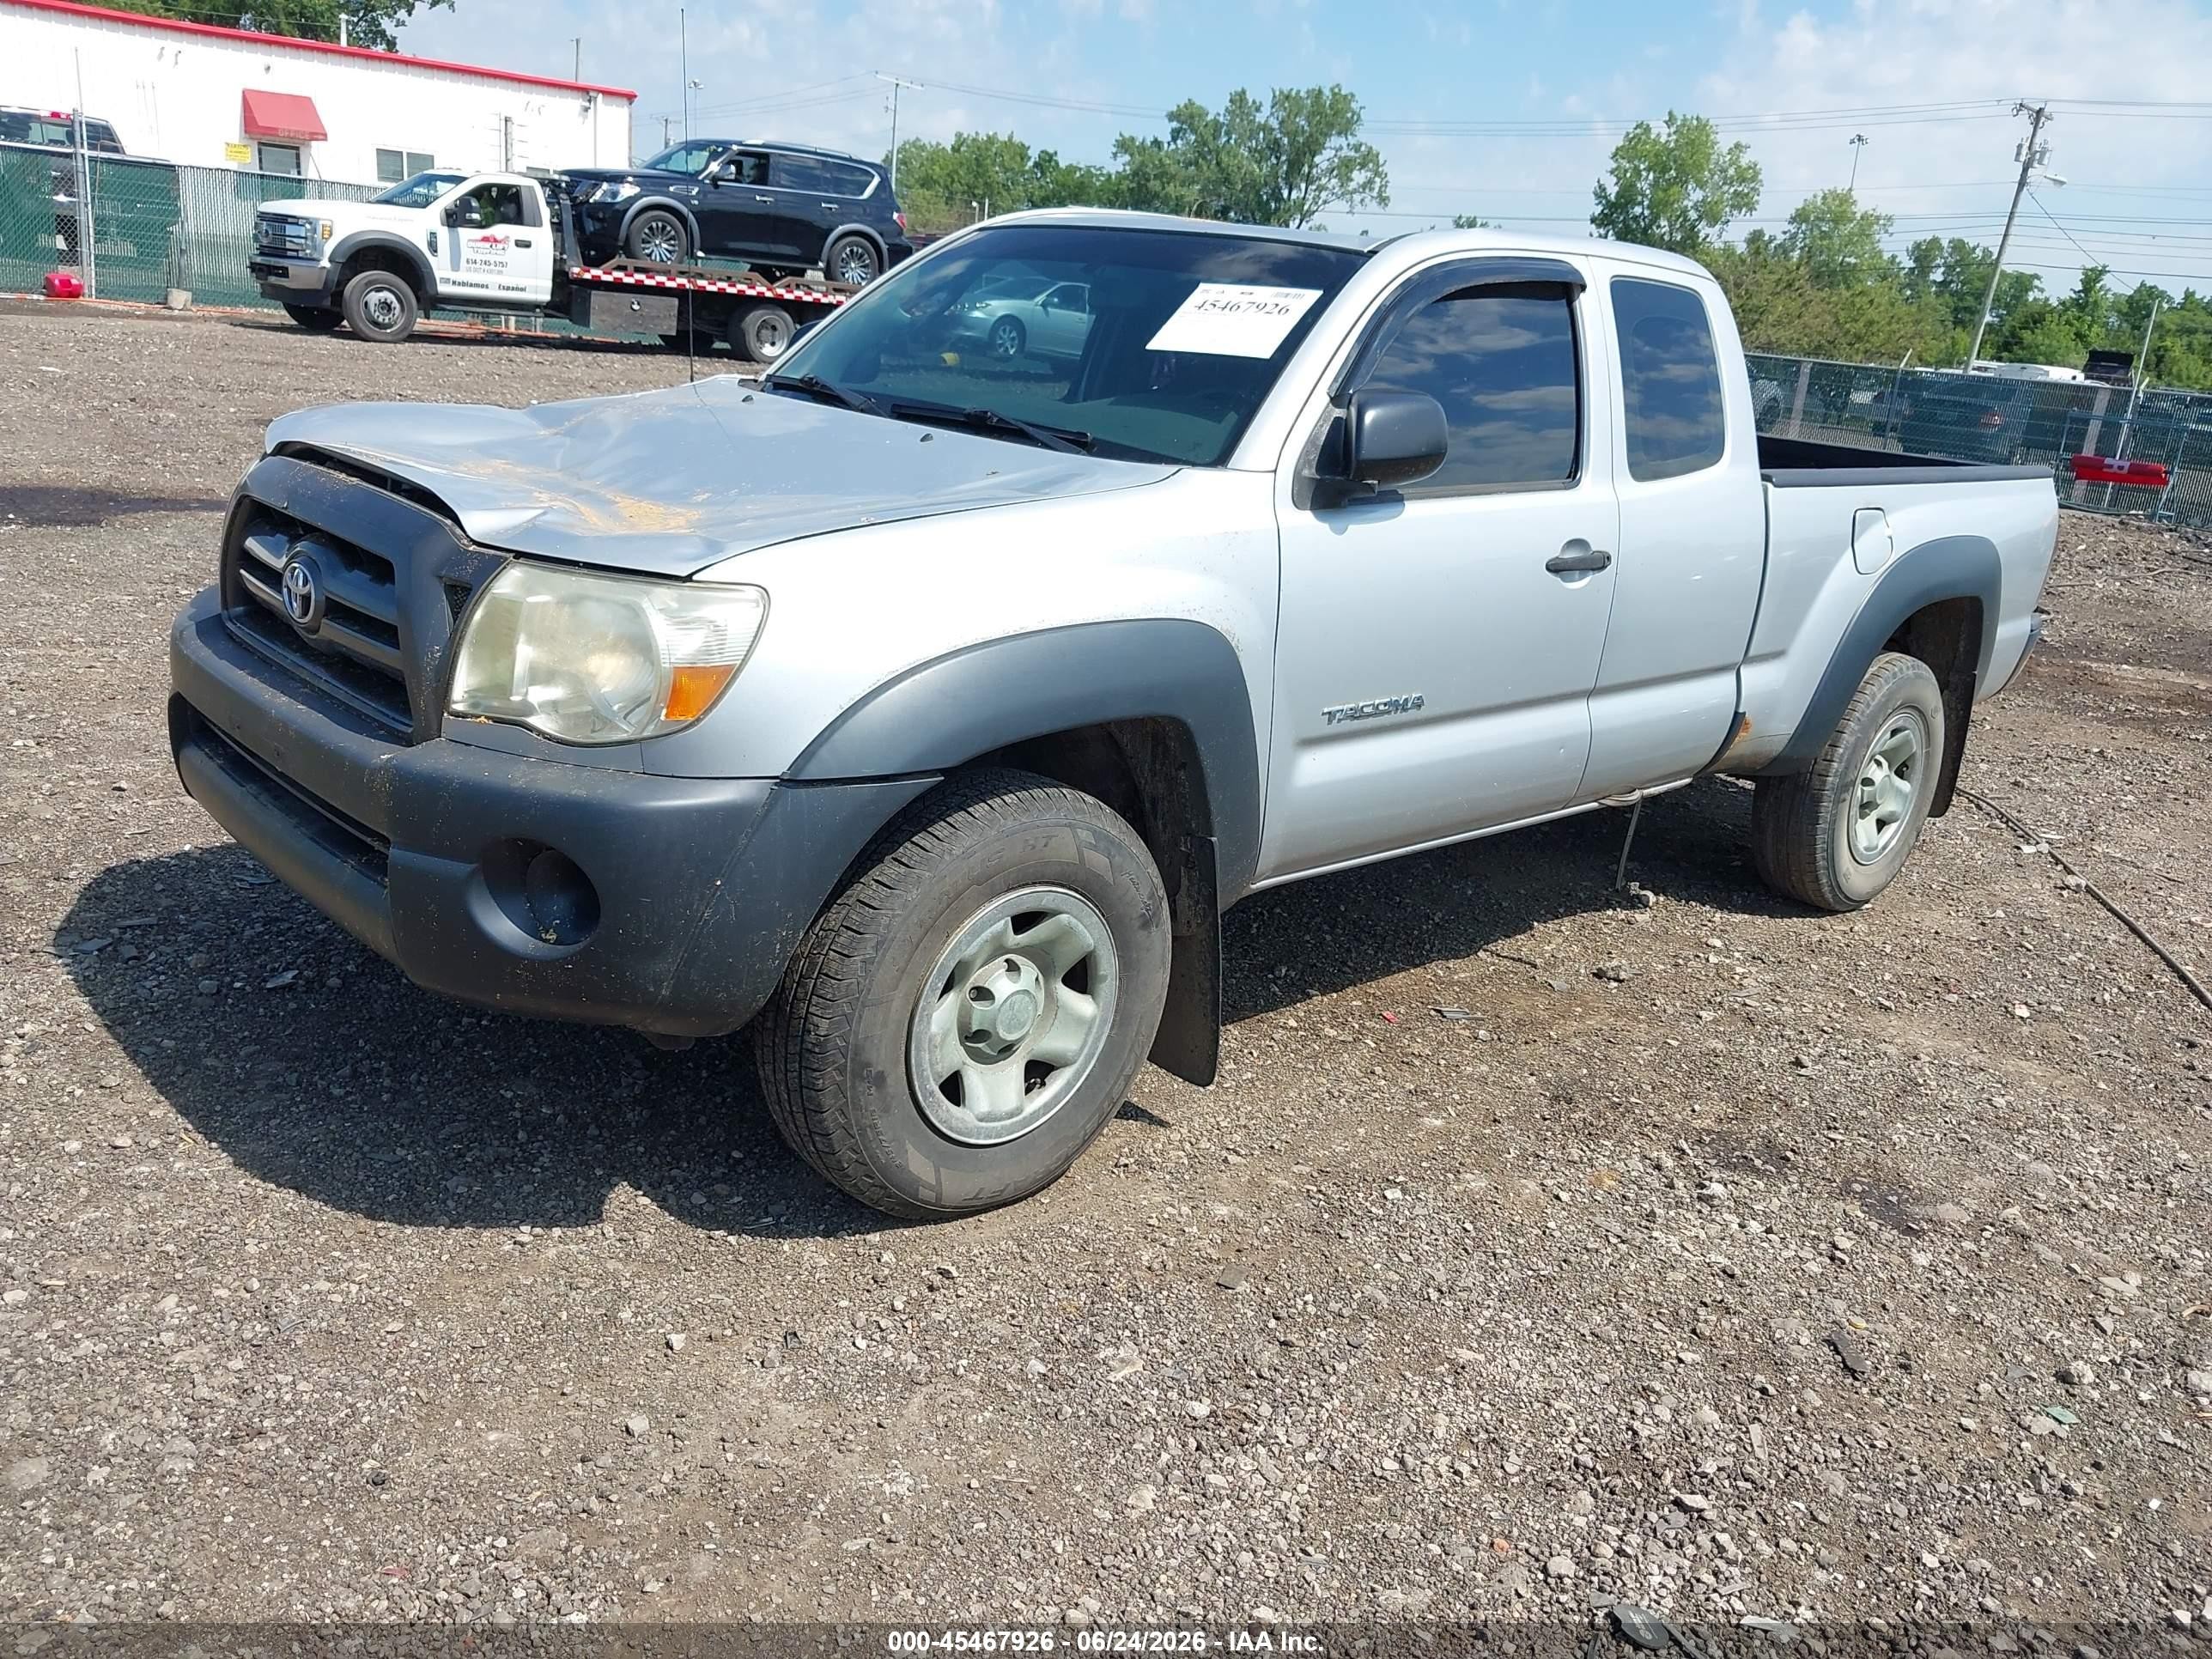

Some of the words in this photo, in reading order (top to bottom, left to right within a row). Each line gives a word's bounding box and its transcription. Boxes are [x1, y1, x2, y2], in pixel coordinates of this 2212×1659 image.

[278, 129, 311, 139] OFFICE
[452, 280, 489, 289] Hablamos
[497, 283, 526, 293] Español
[1194, 299, 1290, 316] 45467926
[1322, 694, 1425, 726] TACOMA
